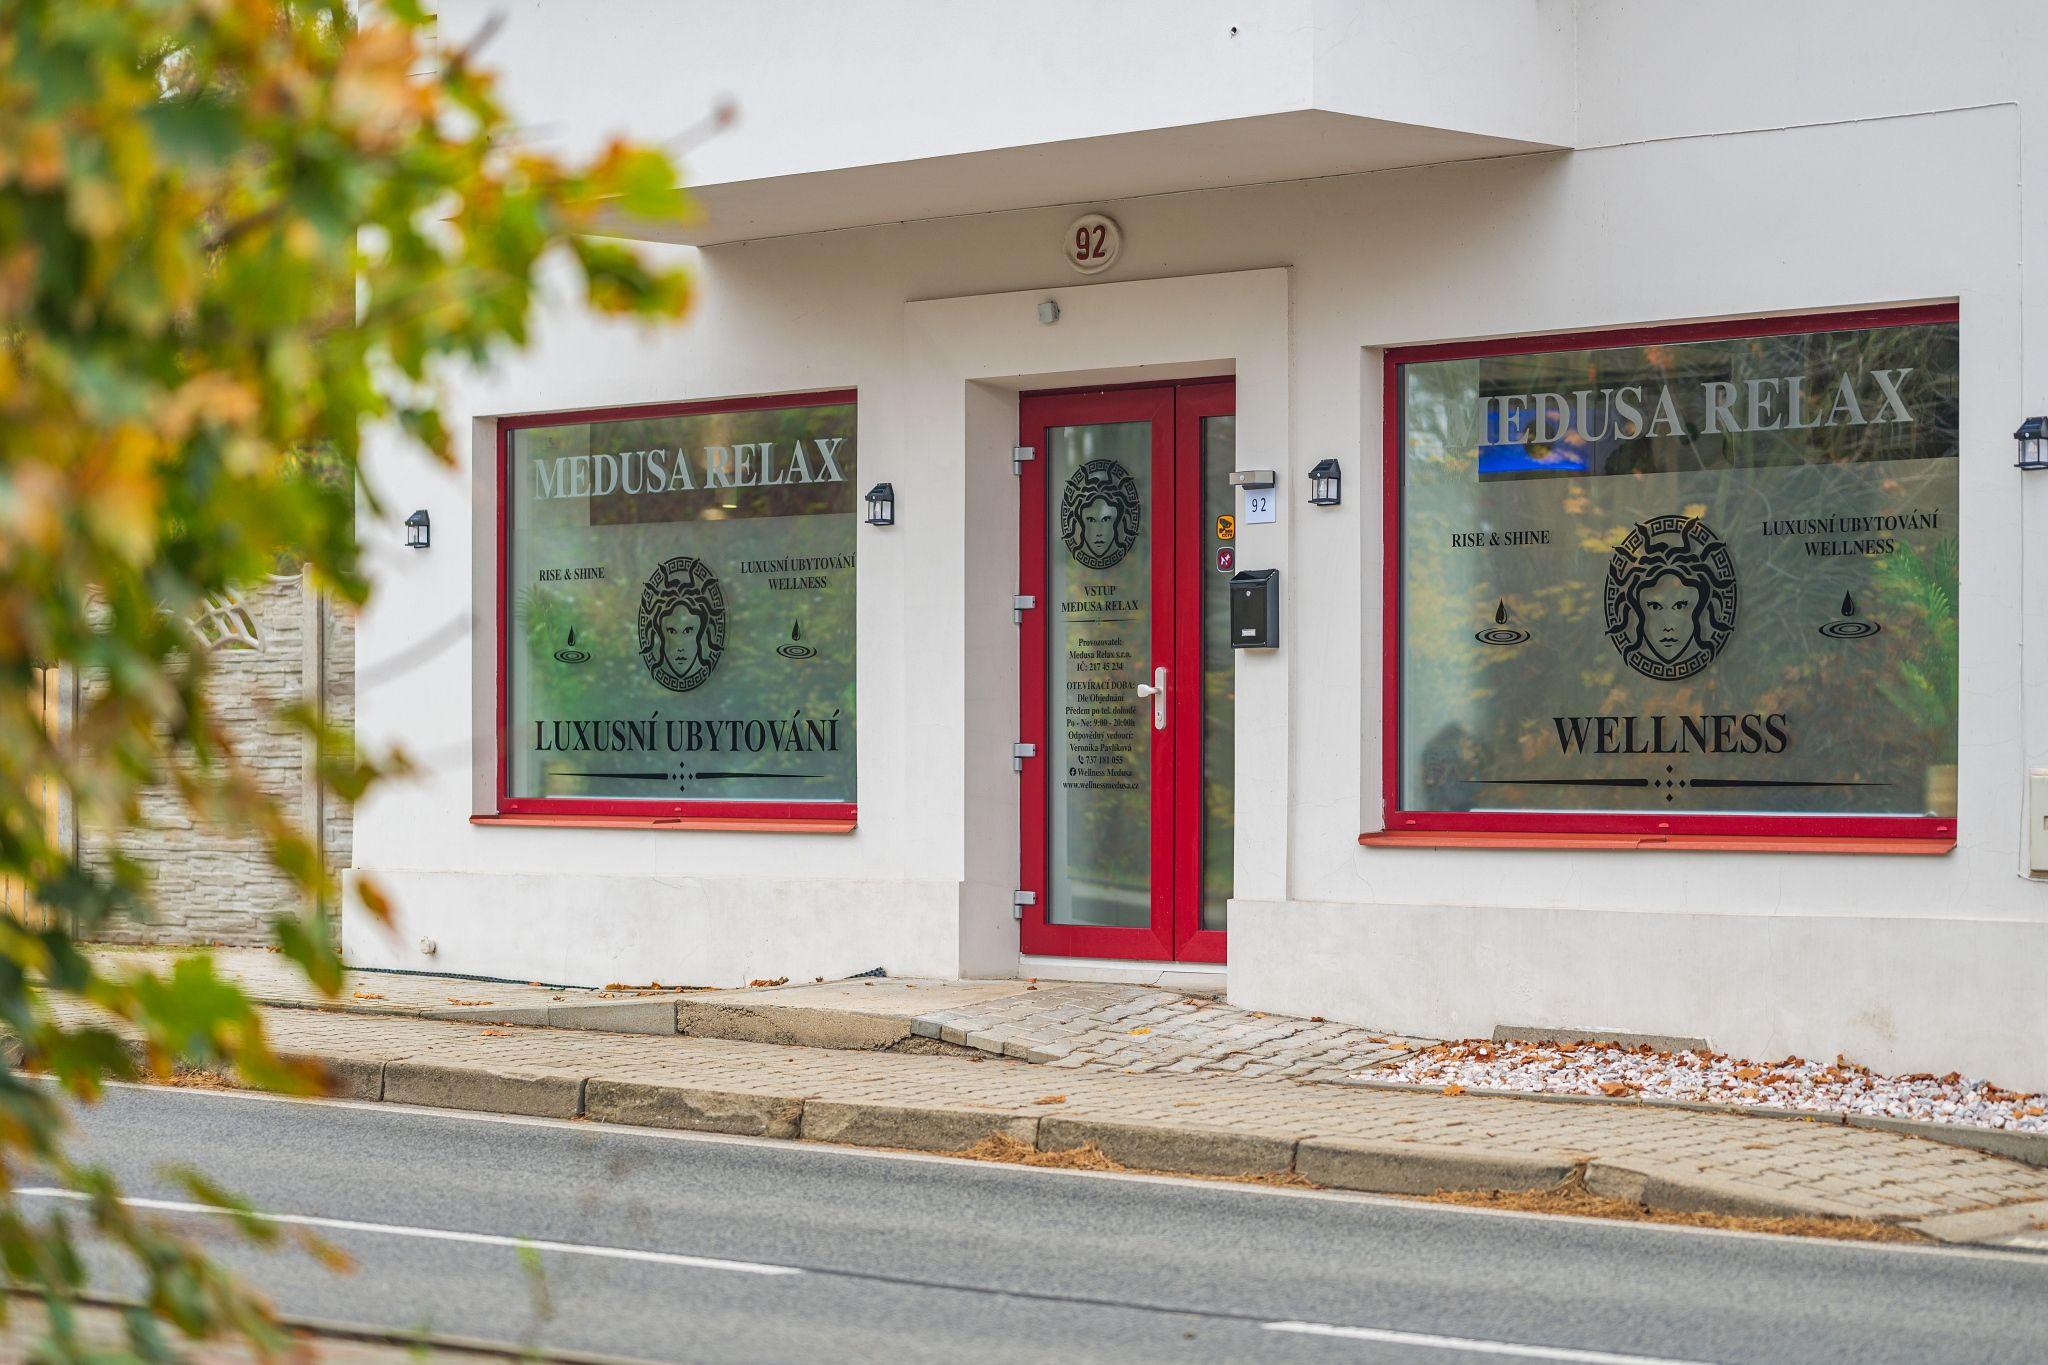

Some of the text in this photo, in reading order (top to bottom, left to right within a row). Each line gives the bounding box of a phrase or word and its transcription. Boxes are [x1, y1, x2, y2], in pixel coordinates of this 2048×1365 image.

[1075, 224, 1106, 261] 92
[1443, 367, 1914, 448] MEDUSA RELAX
[533, 437, 848, 500] MEDUSA RELAX
[1251, 497, 1267, 513] 92
[1762, 508, 1939, 537] LUXUSNÍ UBYTOVÁNÍ
[1451, 530, 1551, 548] RISE & SHINE
[1805, 538, 1894, 557] WELLNESS
[740, 551, 857, 574] LUXUSNÍ UBYTOVÁNÍ
[539, 567, 605, 581] RISE & SHINE
[767, 576, 827, 591] WELLNESS
[1084, 586, 1116, 597] VSTUP
[1061, 600, 1139, 613] MEDUSA RELAX
[1078, 637, 1123, 647] Provozovatel:
[1069, 651, 1095, 660] Medusa
[1096, 650, 1115, 659] Relax
[1066, 680, 1136, 690] OTEVÍRACÍ DOBA:
[1077, 693, 1124, 704] Dle Objednání
[1065, 706, 1090, 715] Předem
[1091, 708, 1101, 717] po
[1066, 718, 1075, 727] Po
[1081, 718, 1092, 727] Ne:
[1093, 718, 1108, 727] 9:00
[535, 708, 840, 753] LUXUSNÍ UBYTOVÁNÍ
[1068, 731, 1104, 741] Odpovědný
[1552, 713, 1788, 756] WELLNESS
[1070, 744, 1098, 752] Veronika
[1086, 755, 1097, 764] 737
[1078, 768, 1133, 777] Wellness Medusa
[1062, 780, 1139, 790] www.wellnessmedusa.cz
